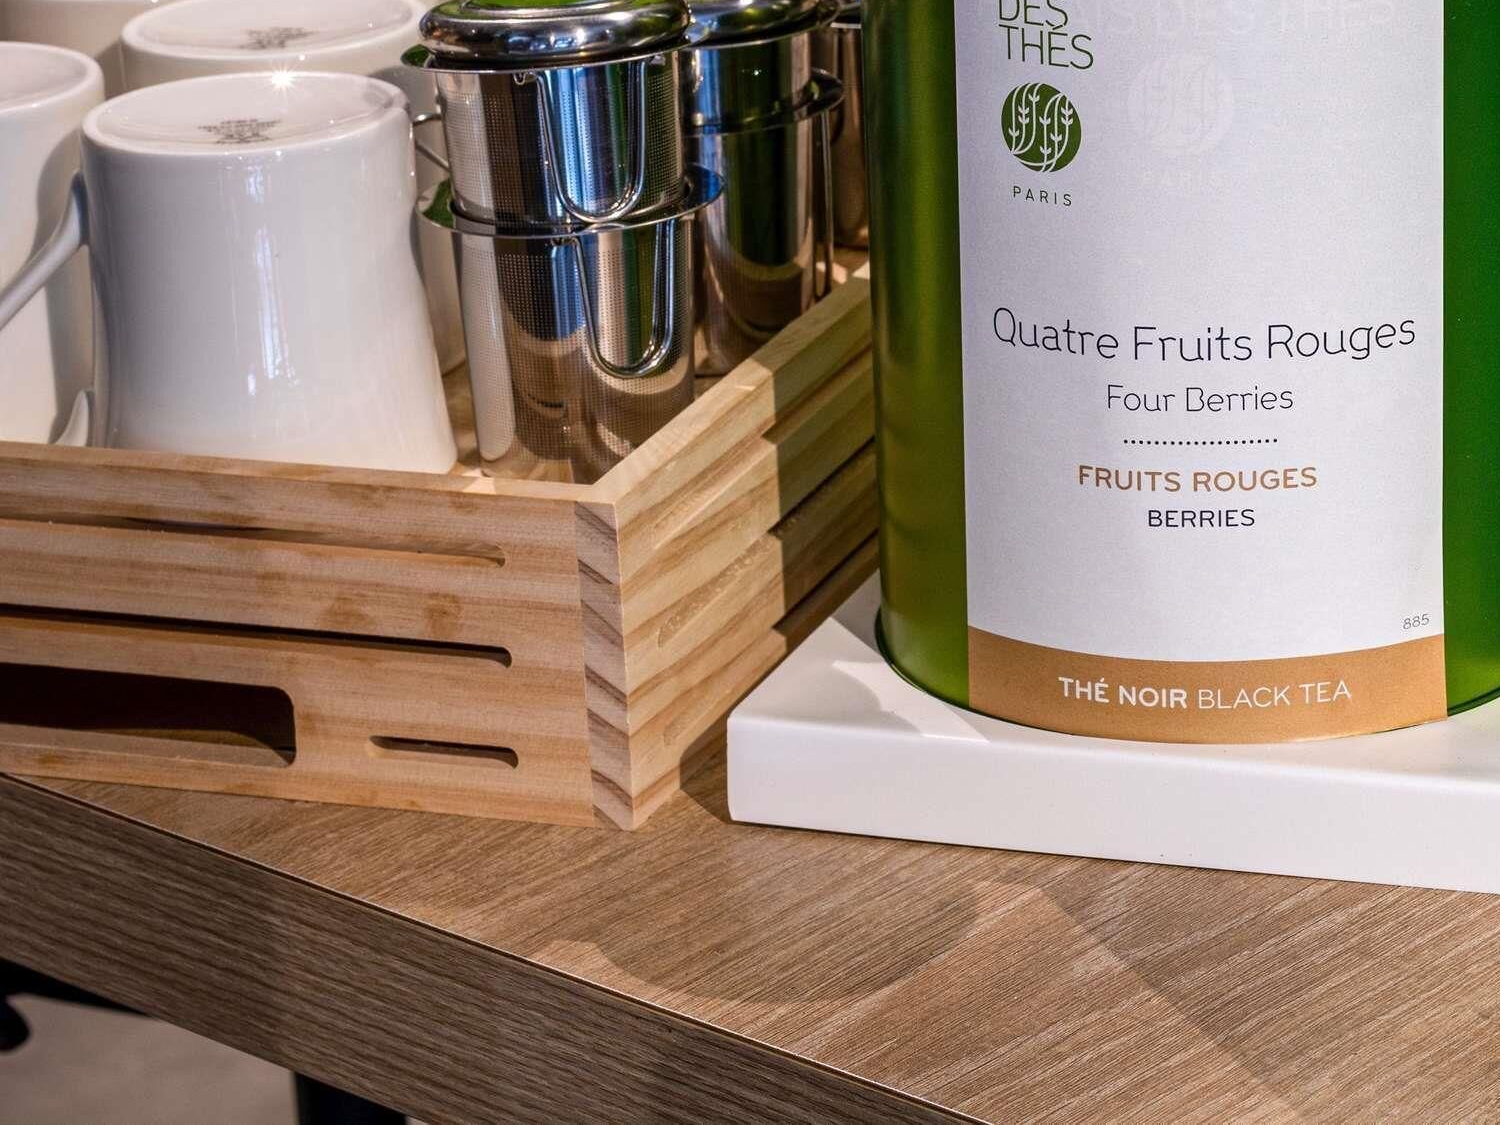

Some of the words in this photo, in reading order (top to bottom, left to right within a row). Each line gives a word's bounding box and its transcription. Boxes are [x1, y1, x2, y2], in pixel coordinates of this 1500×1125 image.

[999, 21, 1094, 70] THÉS
[1013, 186, 1071, 206] PARIS
[994, 308, 1118, 358] Quatre
[1134, 326, 1252, 361] Fruits
[1269, 320, 1415, 360] Rouges
[1108, 385, 1175, 411] Four
[1186, 386, 1293, 412] Berries
[1079, 465, 1180, 492] FRUITS
[1193, 467, 1316, 492] ROUGES
[1149, 509, 1254, 527] BERRIES
[1403, 614, 1429, 629] 885
[1059, 677, 1109, 703] THÉ
[1119, 686, 1187, 708] NOIR
[1199, 686, 1290, 708] BLACK
[1299, 680, 1352, 703] TEA
